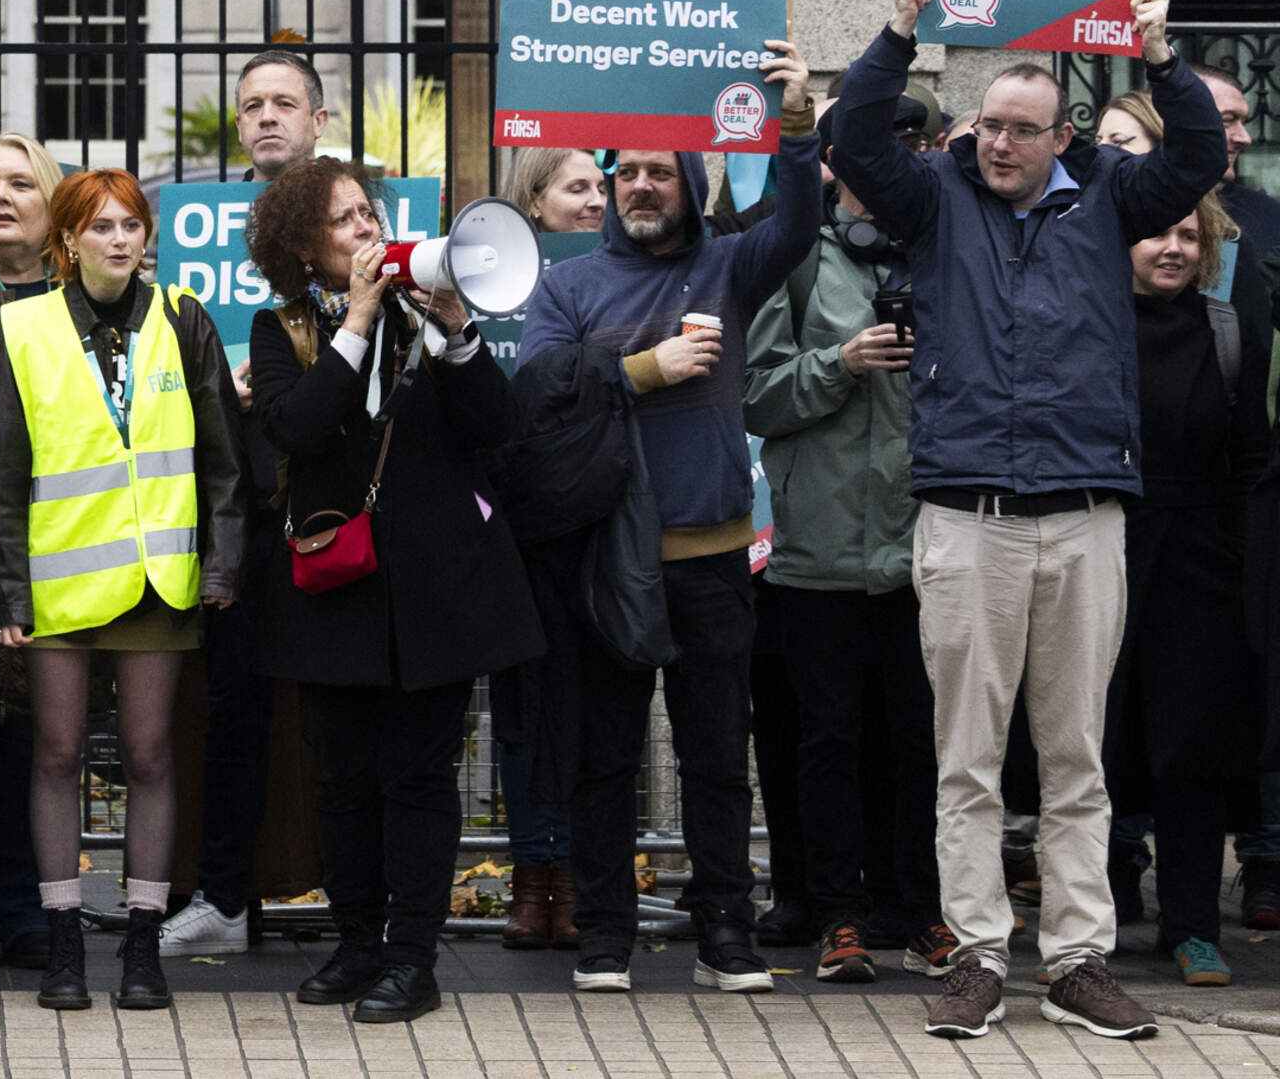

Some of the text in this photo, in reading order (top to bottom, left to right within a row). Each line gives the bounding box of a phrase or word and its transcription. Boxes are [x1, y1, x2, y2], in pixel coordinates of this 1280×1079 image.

[663, 0, 739, 29] Work
[1073, 11, 1133, 46] FÓRSA
[510, 35, 776, 71] Stronger Services
[723, 115, 747, 123] DEAL
[724, 106, 759, 115] BETTER
[504, 113, 541, 138] FÓRSA
